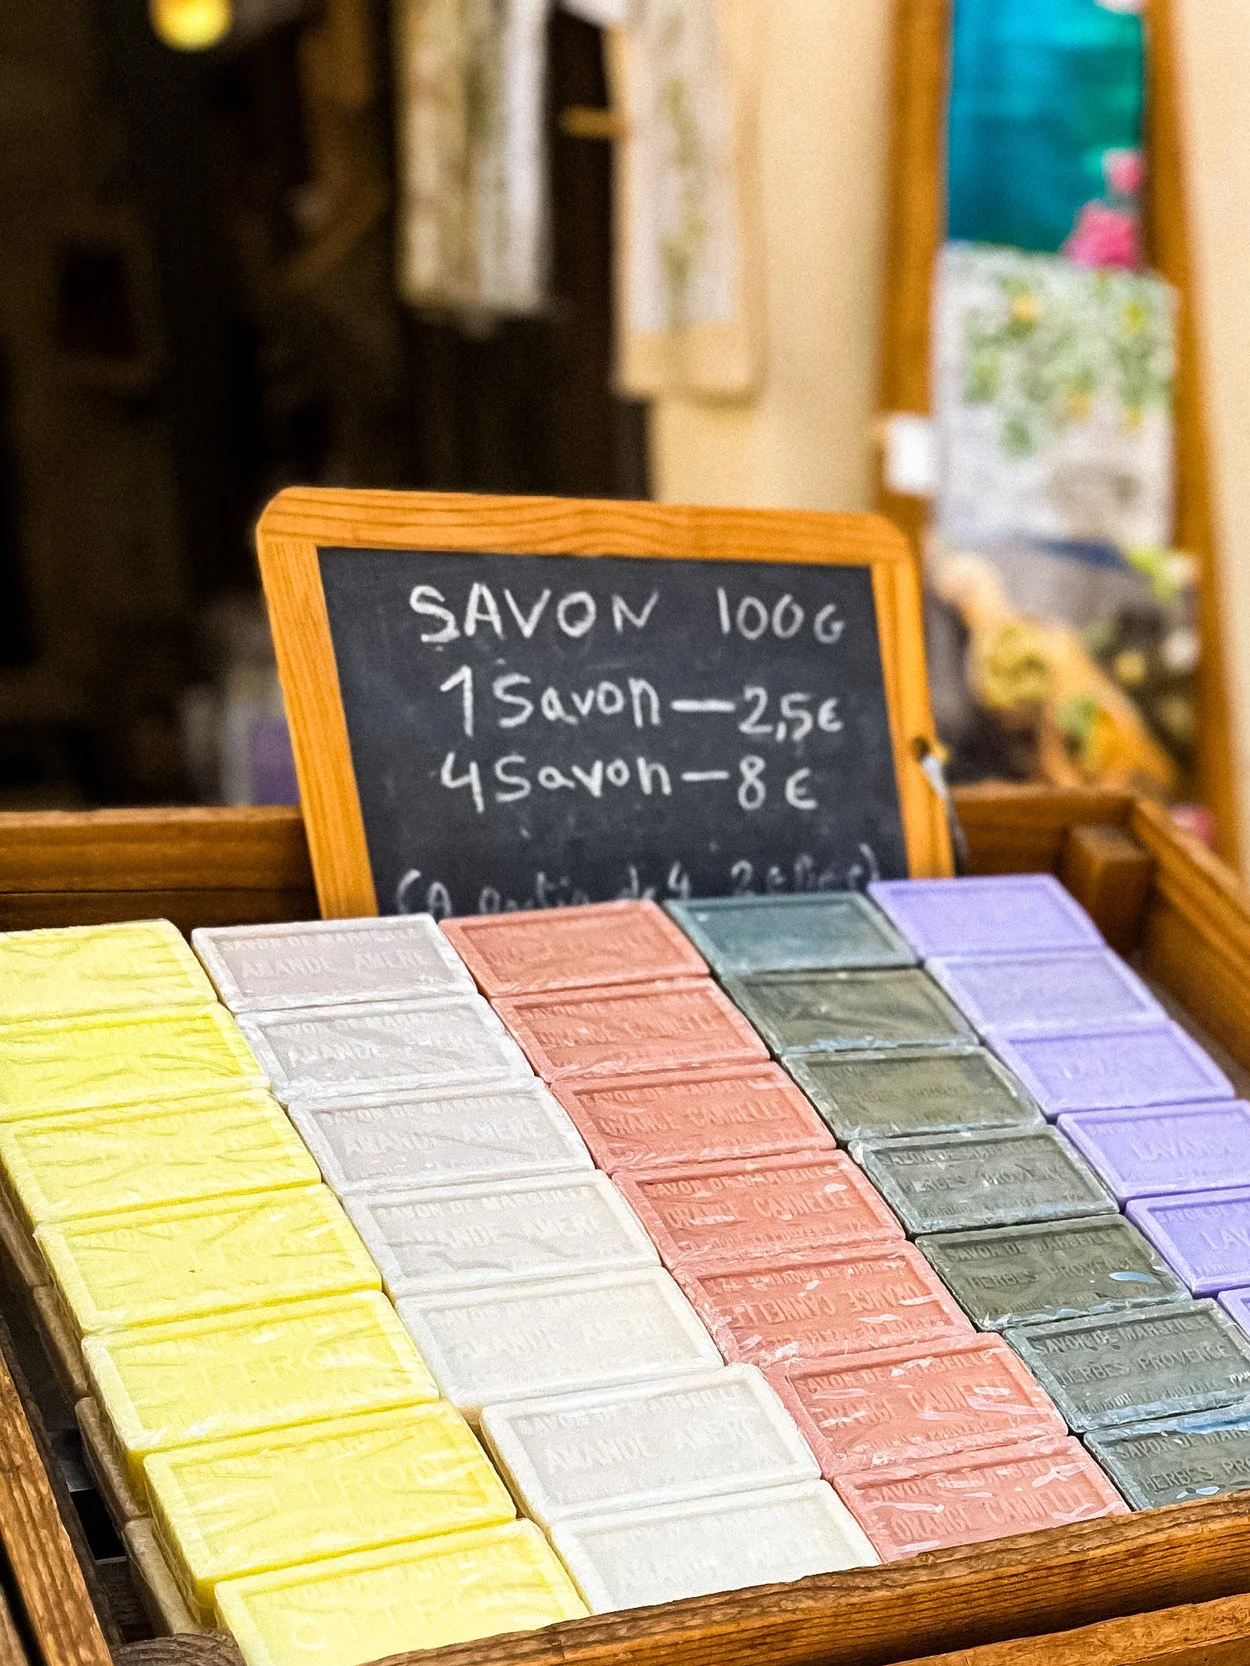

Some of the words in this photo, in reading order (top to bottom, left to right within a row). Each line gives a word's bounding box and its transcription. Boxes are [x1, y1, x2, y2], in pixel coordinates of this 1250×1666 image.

[410, 583, 659, 643] SAVON
[718, 587, 846, 645] 100G
[1055, 1360, 1131, 1387] HERBES
[1136, 1342, 1231, 1372] PROVENCE
[1120, 1434, 1170, 1460] SAVON
[1141, 1464, 1215, 1494] HERBES
[890, 1504, 967, 1540] ORANGE
